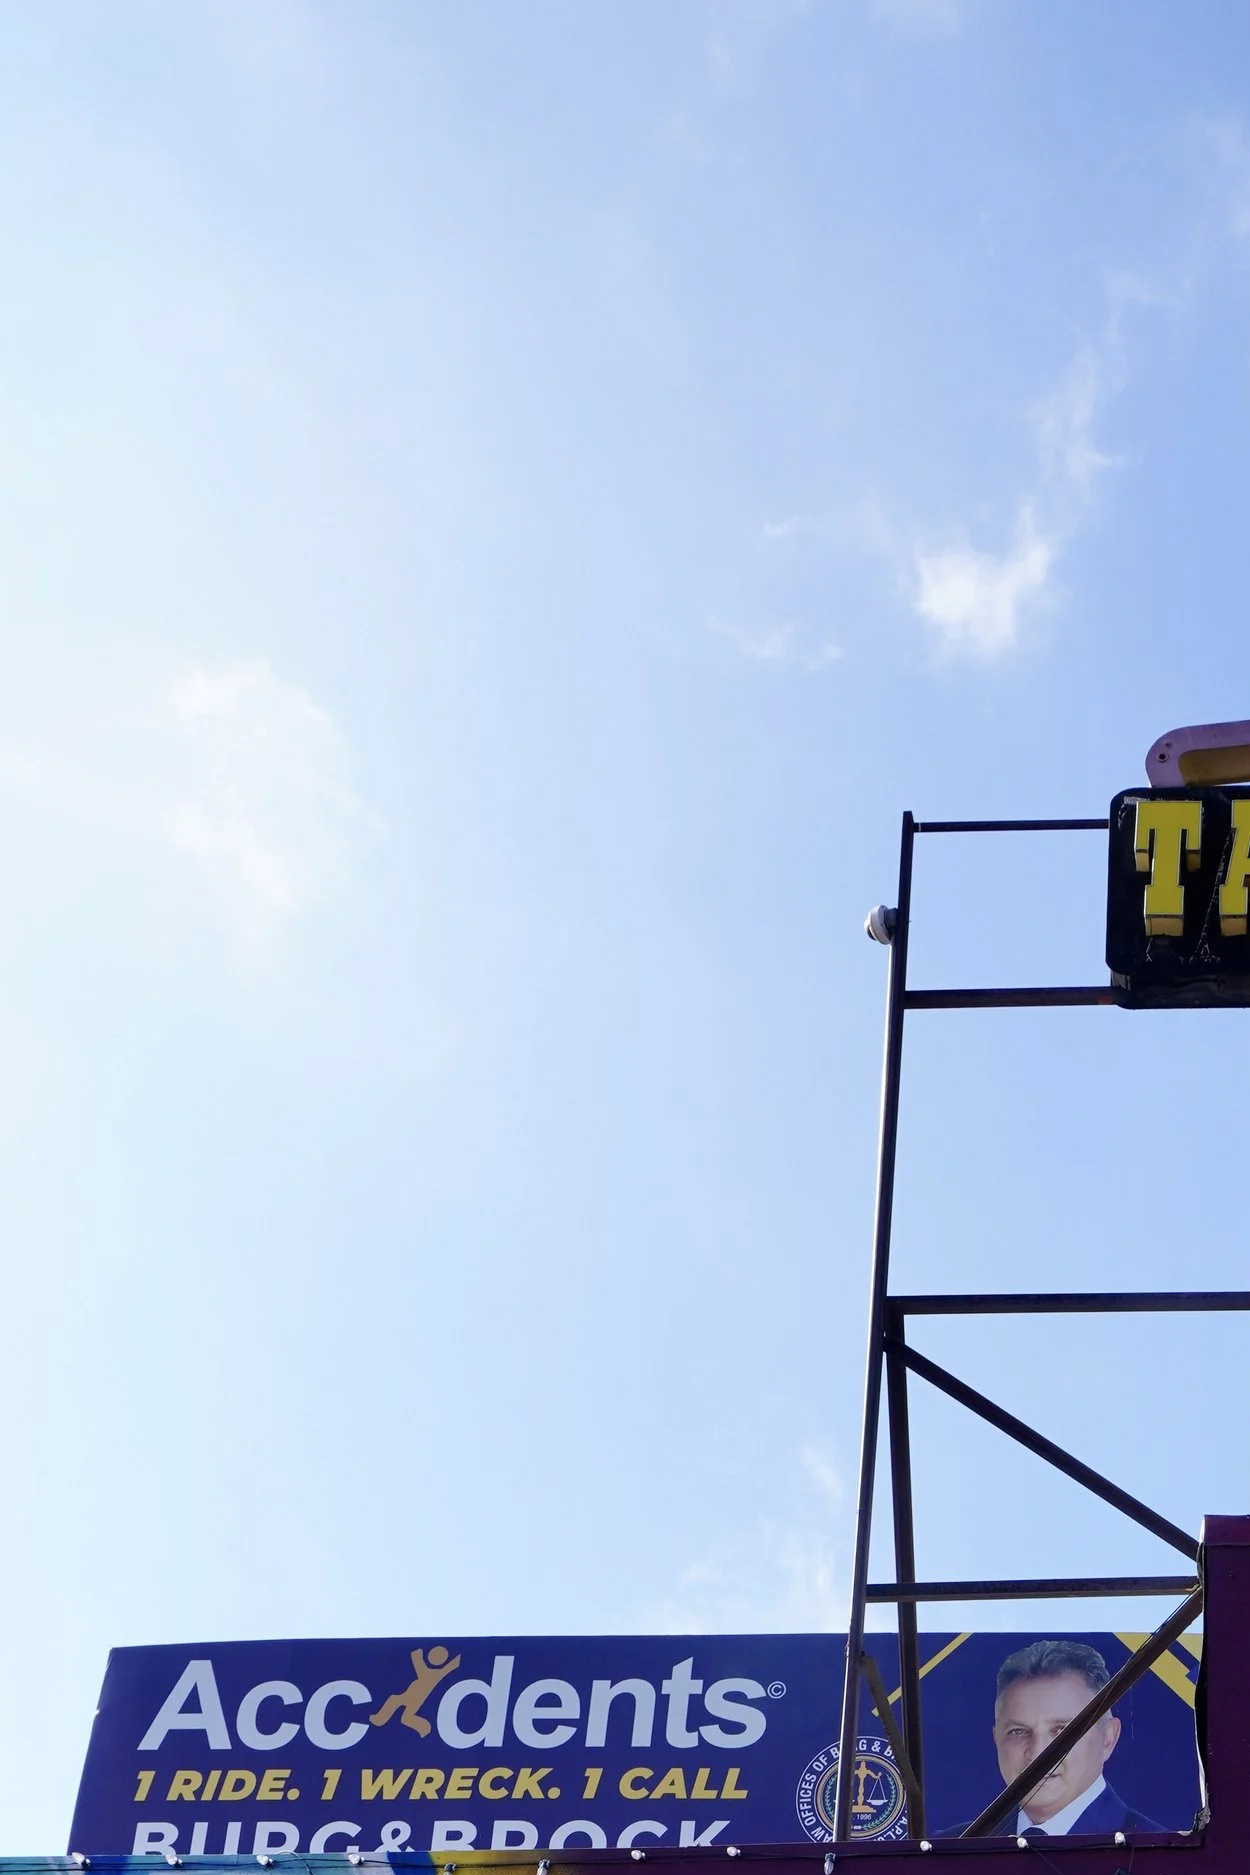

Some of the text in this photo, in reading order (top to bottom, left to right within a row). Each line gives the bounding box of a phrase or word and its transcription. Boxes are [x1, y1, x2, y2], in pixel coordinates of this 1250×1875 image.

[133, 1766, 750, 1802] 1 RIDE. 1 WRECK. 1 CALL
[799, 1773, 818, 1827] OFFICES
[812, 1755, 829, 1772] OF
[830, 1739, 867, 1759] BG
[871, 1740, 881, 1752] &
